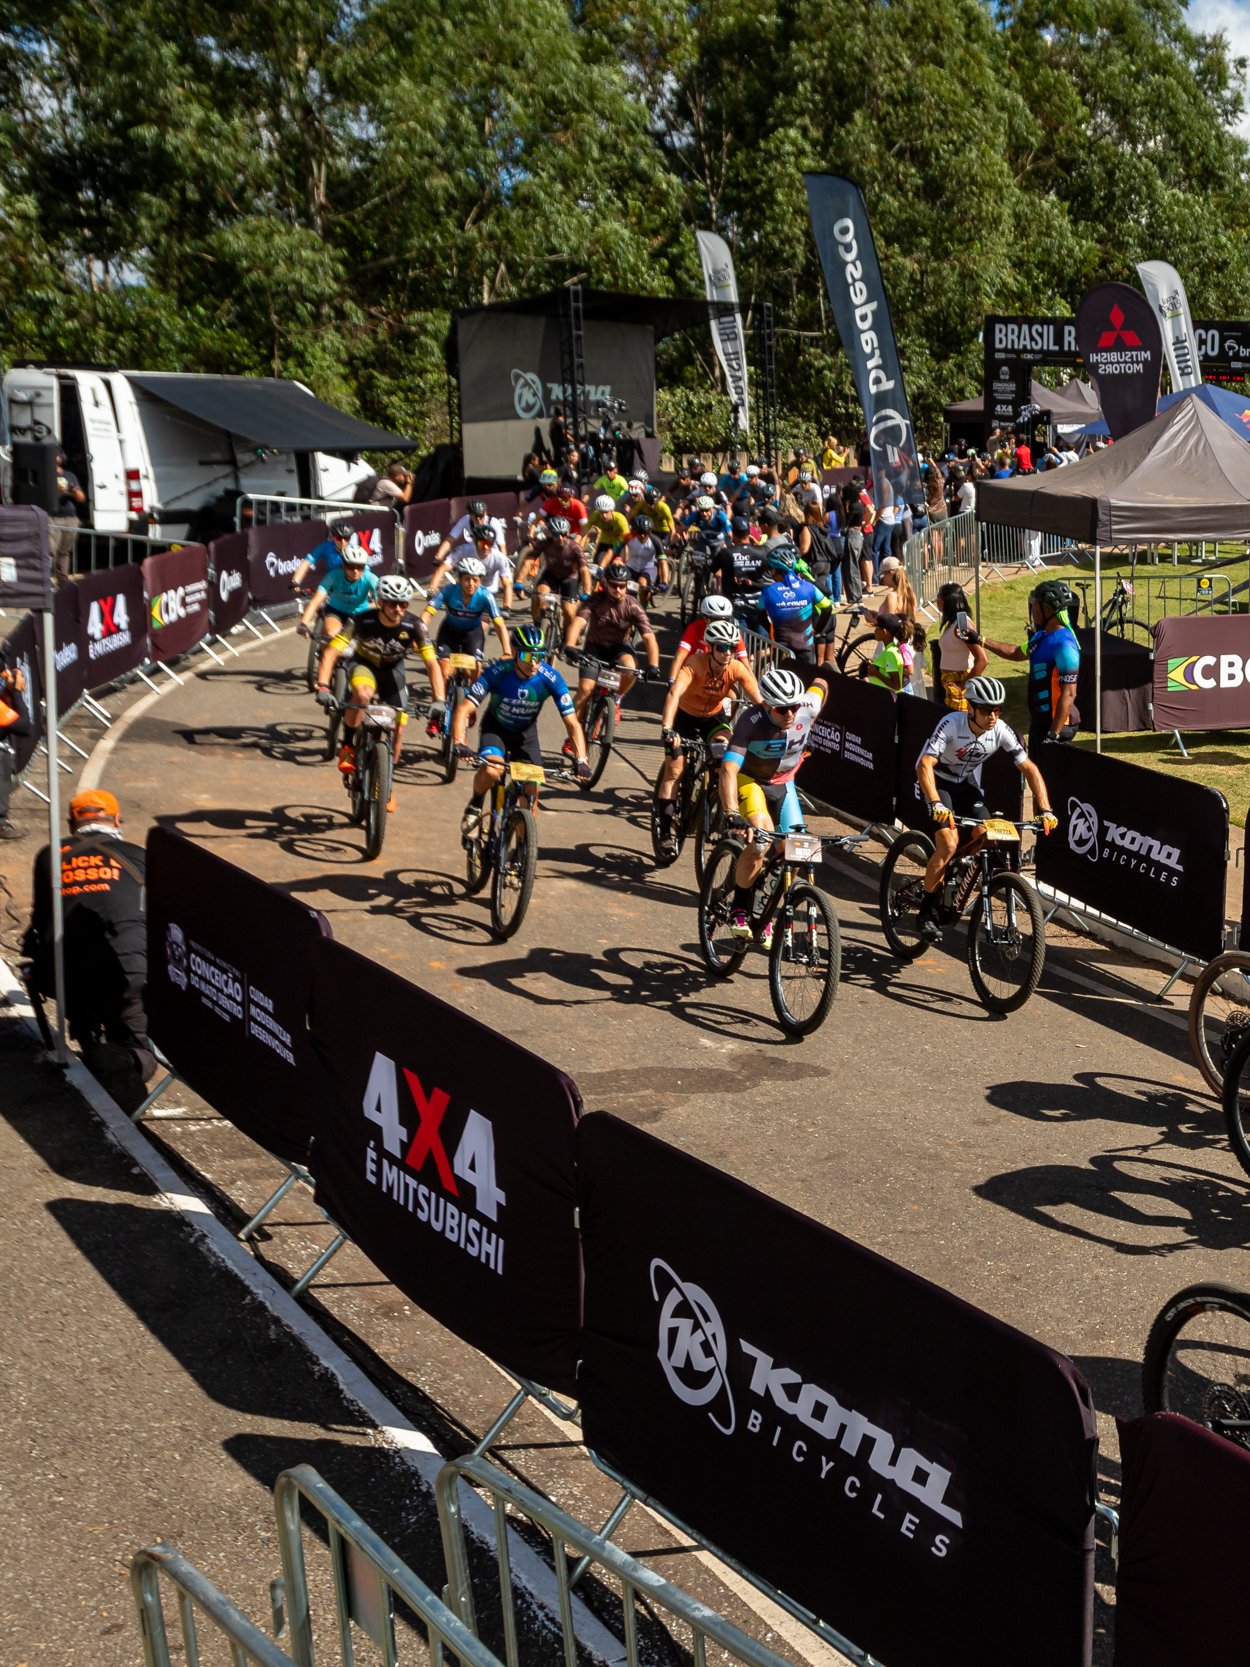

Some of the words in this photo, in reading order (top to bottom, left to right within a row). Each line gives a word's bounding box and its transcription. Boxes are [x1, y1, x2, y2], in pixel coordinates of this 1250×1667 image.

[994, 323, 1059, 350] BRASIL
[87, 593, 130, 640] 4X4
[161, 586, 187, 625] CBC
[96, 630, 132, 657] MITSUBISHI
[750, 711, 762, 724] BH
[811, 722, 840, 743] ONCEIÇÃO
[844, 741, 873, 760] MODERNIZAR
[845, 731, 862, 745] CUIDAR
[844, 750, 874, 770] DESENVOLVER
[1103, 848, 1179, 887] BICYCLES
[189, 952, 243, 1002] CONCEIÇÃO
[217, 991, 244, 1019] DENTRO
[249, 985, 274, 1014] CUIDAR
[249, 1003, 293, 1048] MODERNIZAR
[249, 1020, 297, 1067] DESENVOLVER
[362, 1050, 506, 1222] 4X4
[365, 1140, 377, 1185] É
[382, 1157, 505, 1276] MITSUBISHI
[746, 1409, 950, 1558] BICYCLES
